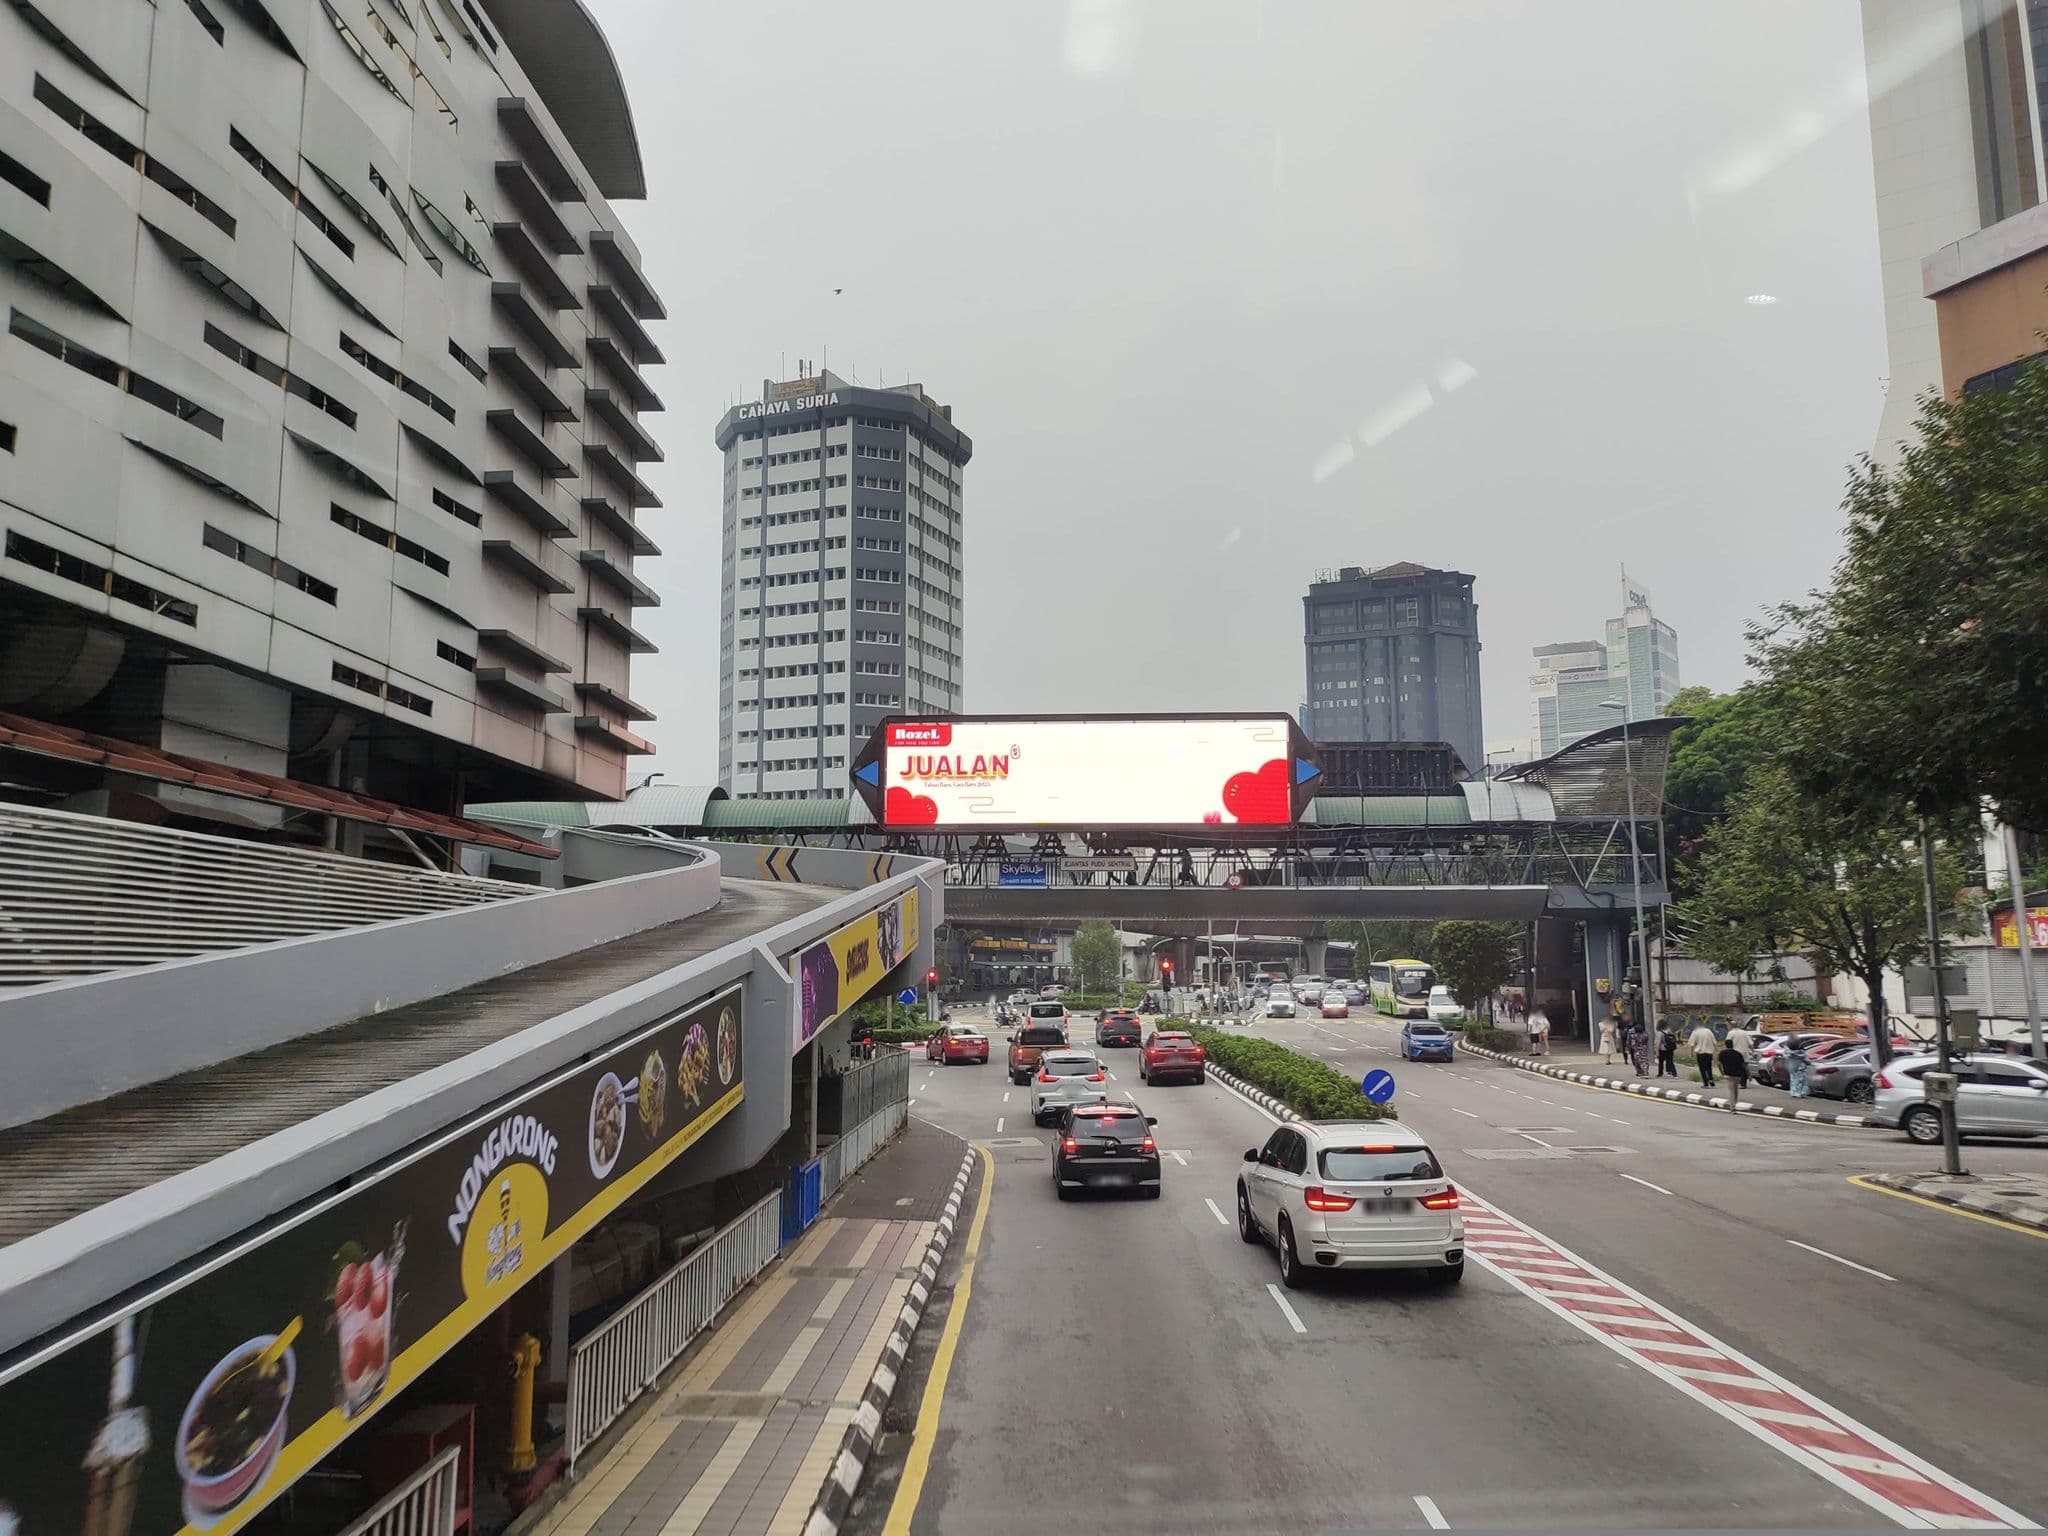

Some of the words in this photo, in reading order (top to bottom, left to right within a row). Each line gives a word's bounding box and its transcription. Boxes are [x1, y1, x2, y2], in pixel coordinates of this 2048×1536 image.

[739, 400, 791, 420] CAHAYA
[797, 392, 840, 411] SURIA
[899, 754, 1009, 779] JUALAN
[447, 1114, 559, 1248] NONGKRONG
